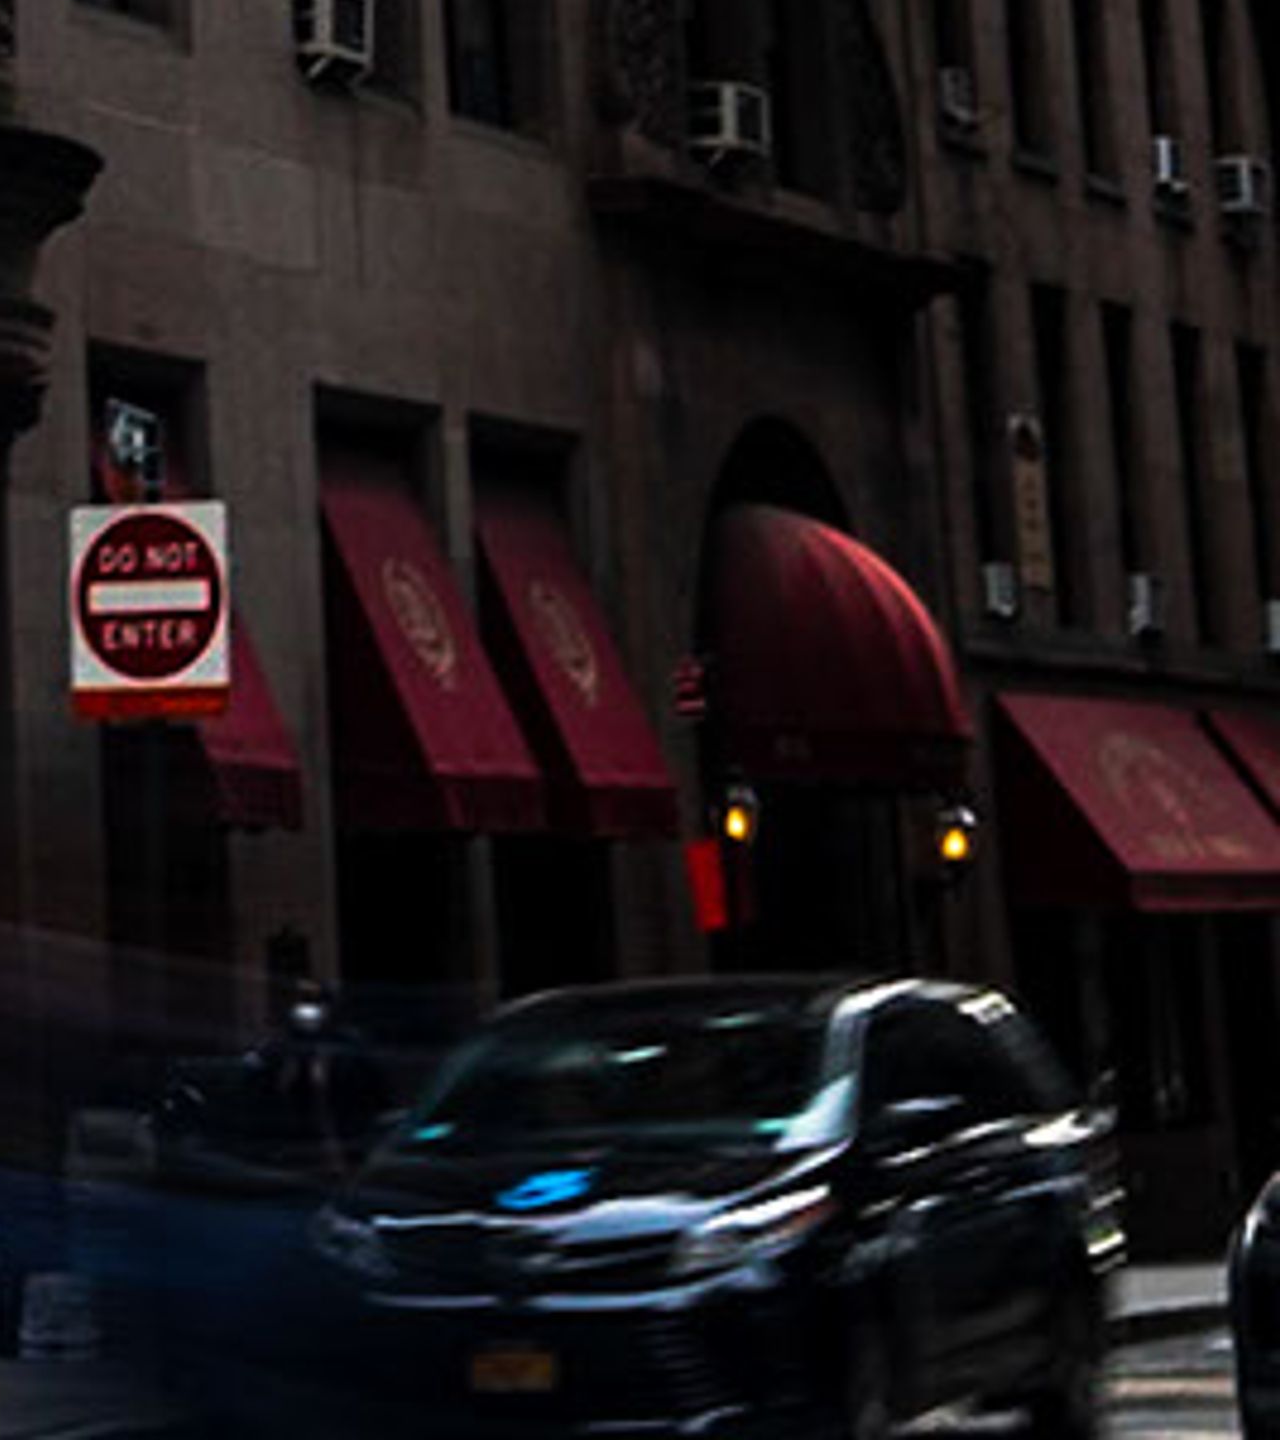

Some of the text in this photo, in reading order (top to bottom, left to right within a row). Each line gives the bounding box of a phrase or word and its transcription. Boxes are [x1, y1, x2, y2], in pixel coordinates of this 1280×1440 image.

[97, 541, 198, 573] DO NOT
[103, 619, 196, 650] ENTER
